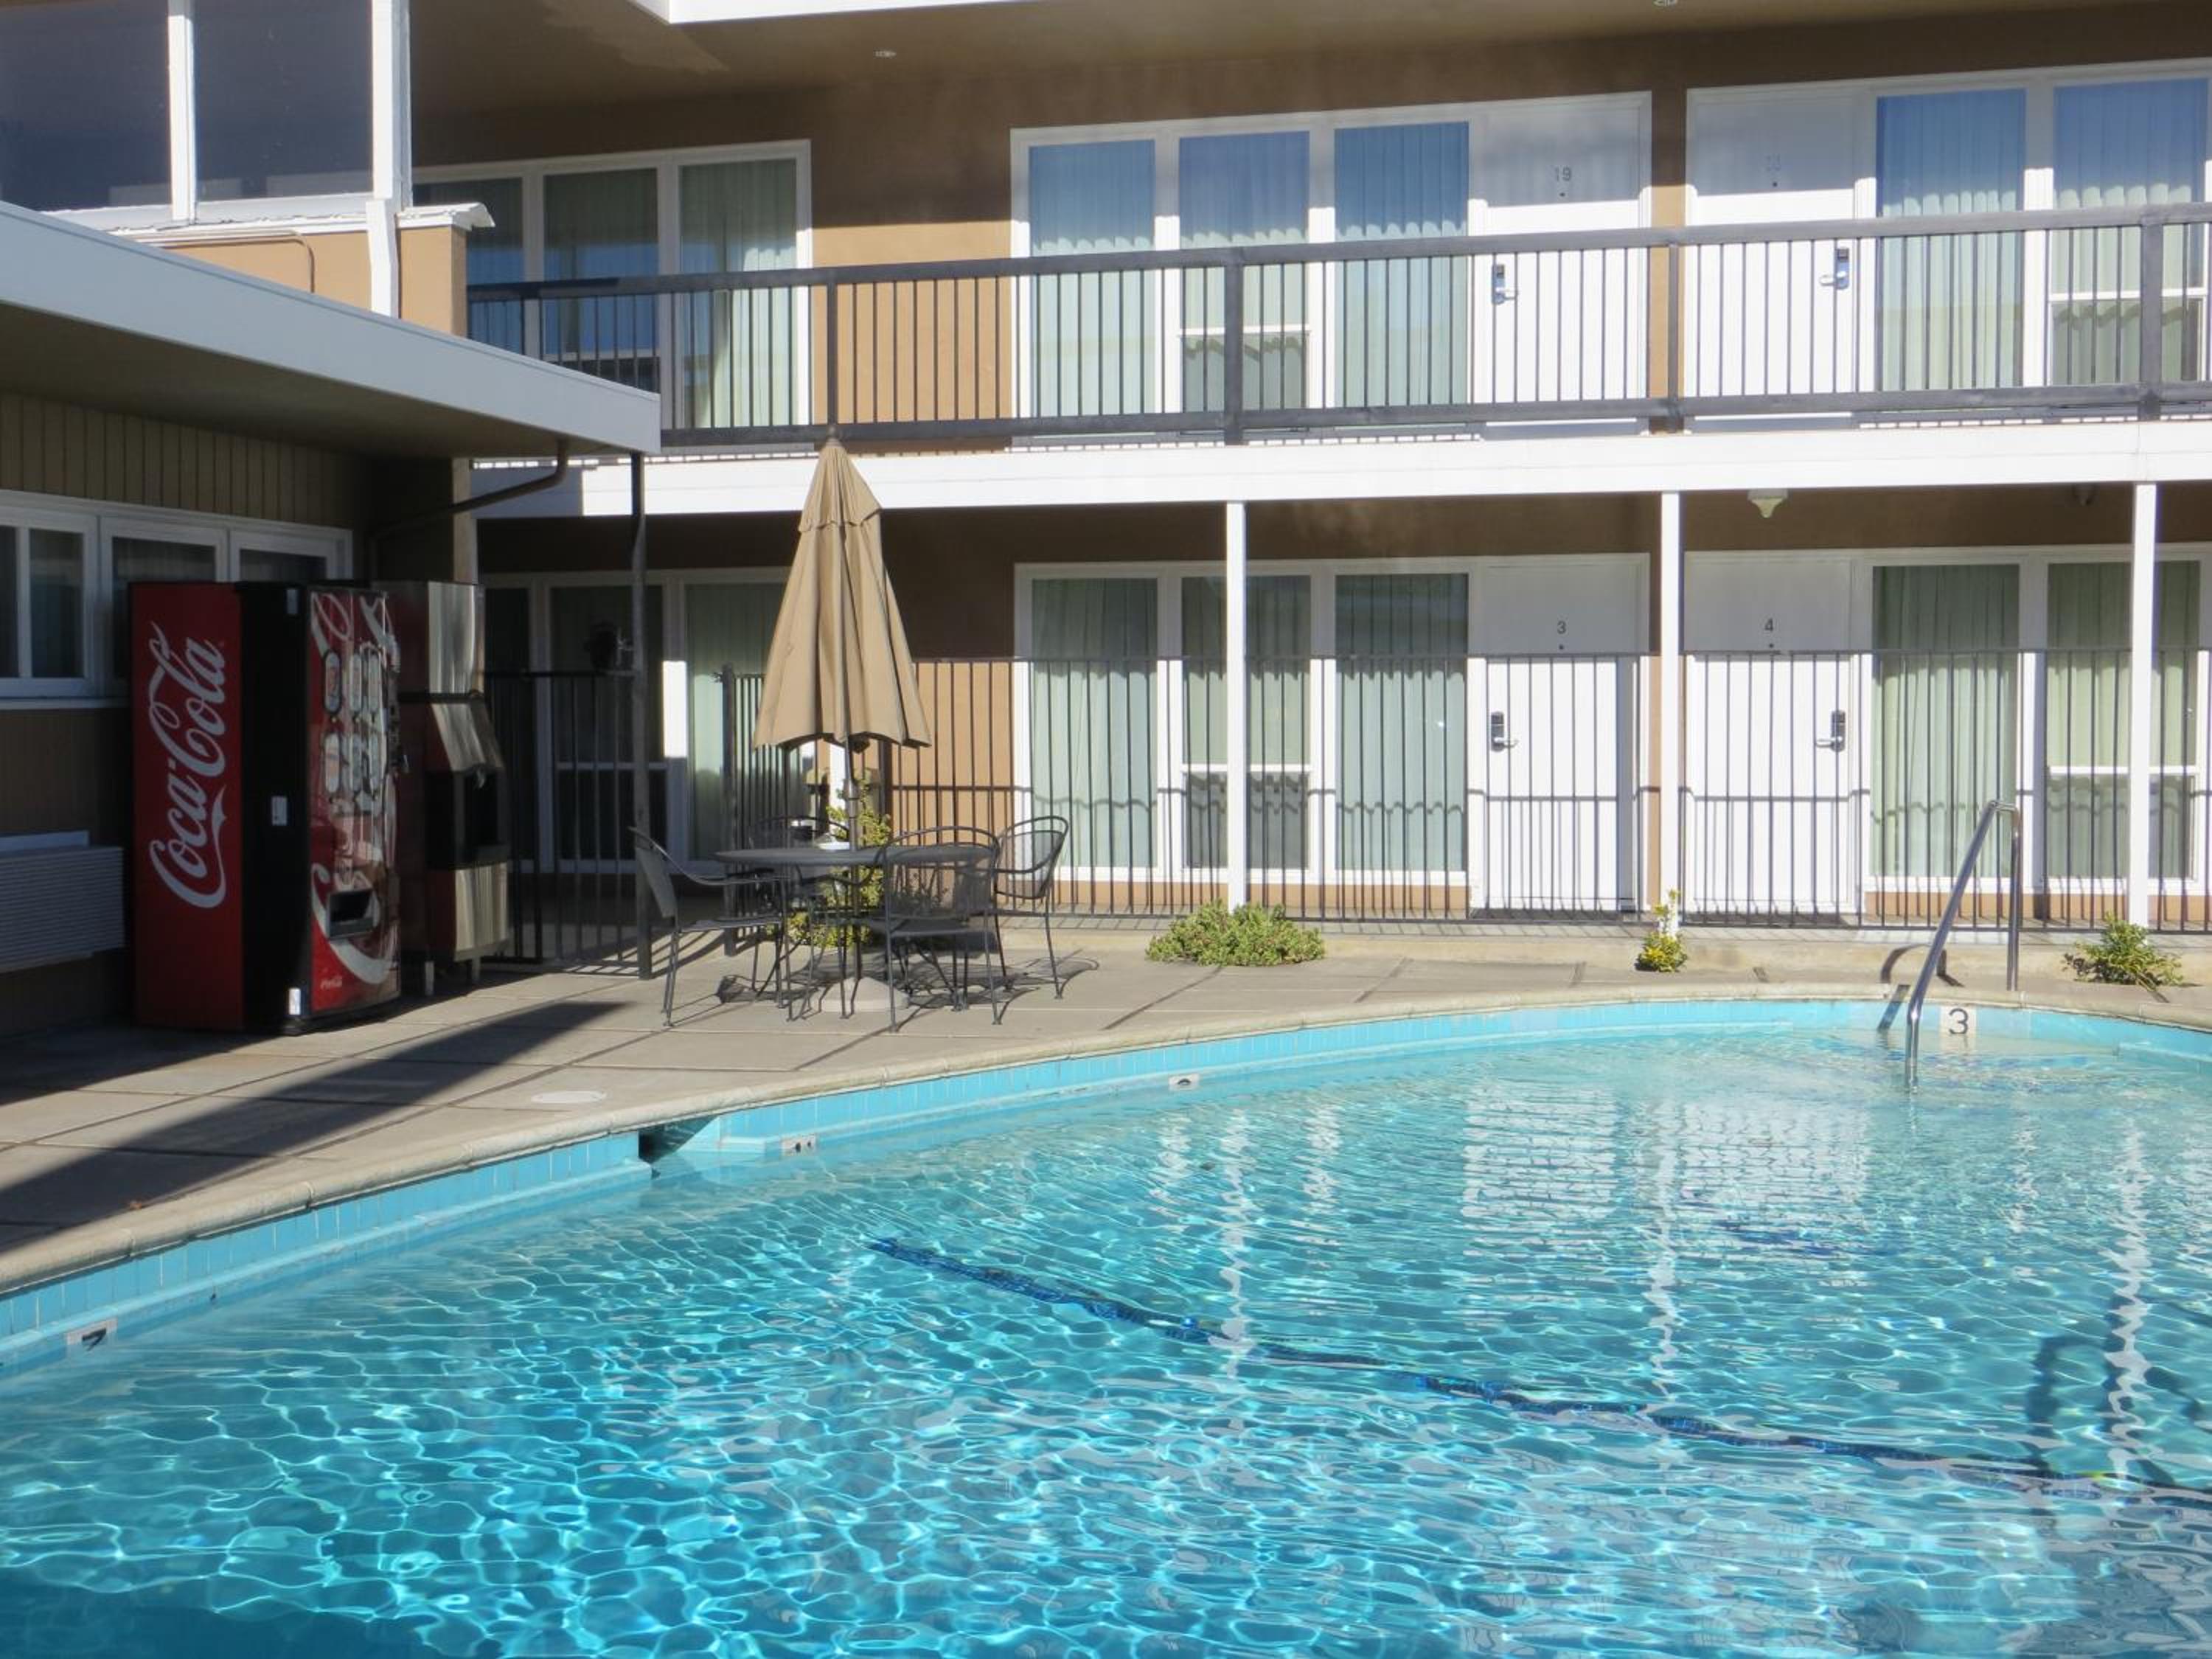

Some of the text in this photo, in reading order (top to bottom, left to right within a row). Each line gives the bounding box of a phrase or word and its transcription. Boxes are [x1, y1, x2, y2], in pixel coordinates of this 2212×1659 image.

[1555, 167, 1571, 181] 19
[1557, 621, 1566, 634] 3
[1764, 618, 1773, 633] 4
[149, 620, 226, 908] Coca-Cola
[1949, 1008, 1969, 1034] 3
